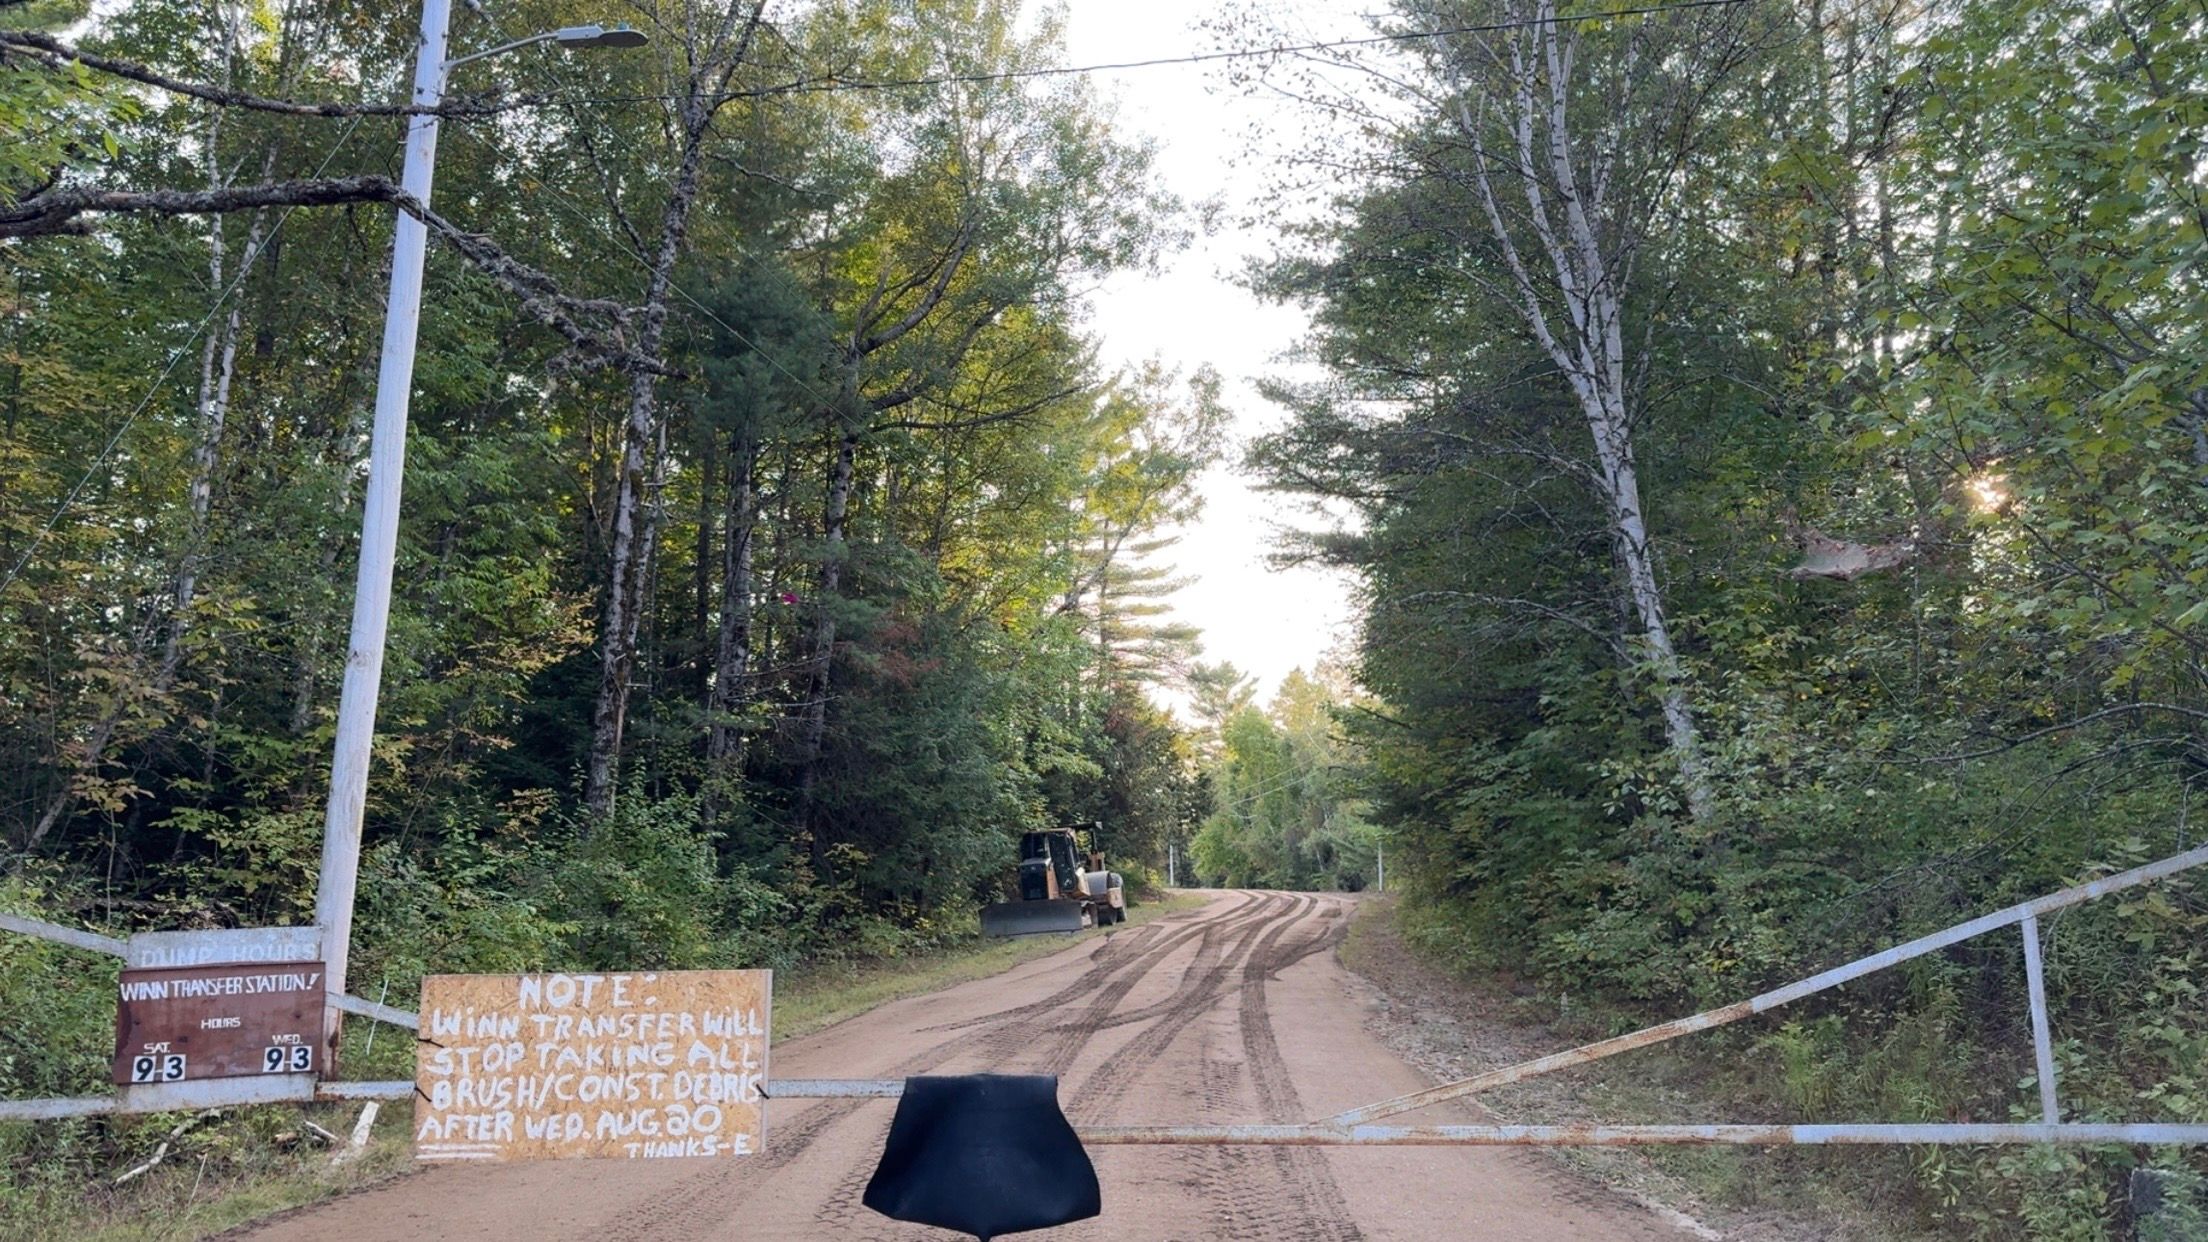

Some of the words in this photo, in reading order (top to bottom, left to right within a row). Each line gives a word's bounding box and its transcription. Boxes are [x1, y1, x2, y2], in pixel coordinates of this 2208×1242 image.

[141, 947, 213, 967] DUMP
[232, 943, 316, 962] HOURS
[120, 982, 169, 1002] WINN
[171, 977, 243, 997] TRANSFER
[245, 973, 321, 994] STATION!
[519, 973, 657, 1009] NOTE:
[201, 1017, 241, 1029] HOURS
[529, 1012, 697, 1041] TRANSFER
[143, 1042, 171, 1055] SAT.
[272, 1034, 304, 1046] WED.
[425, 1042, 526, 1077] STOP
[687, 1039, 760, 1070] ALL
[673, 1070, 763, 1104] DEBRIS
[417, 1111, 515, 1142] AFTER
[525, 1112, 592, 1142] WED.
[597, 1108, 663, 1141] AUG.
[664, 1104, 722, 1136] 20
